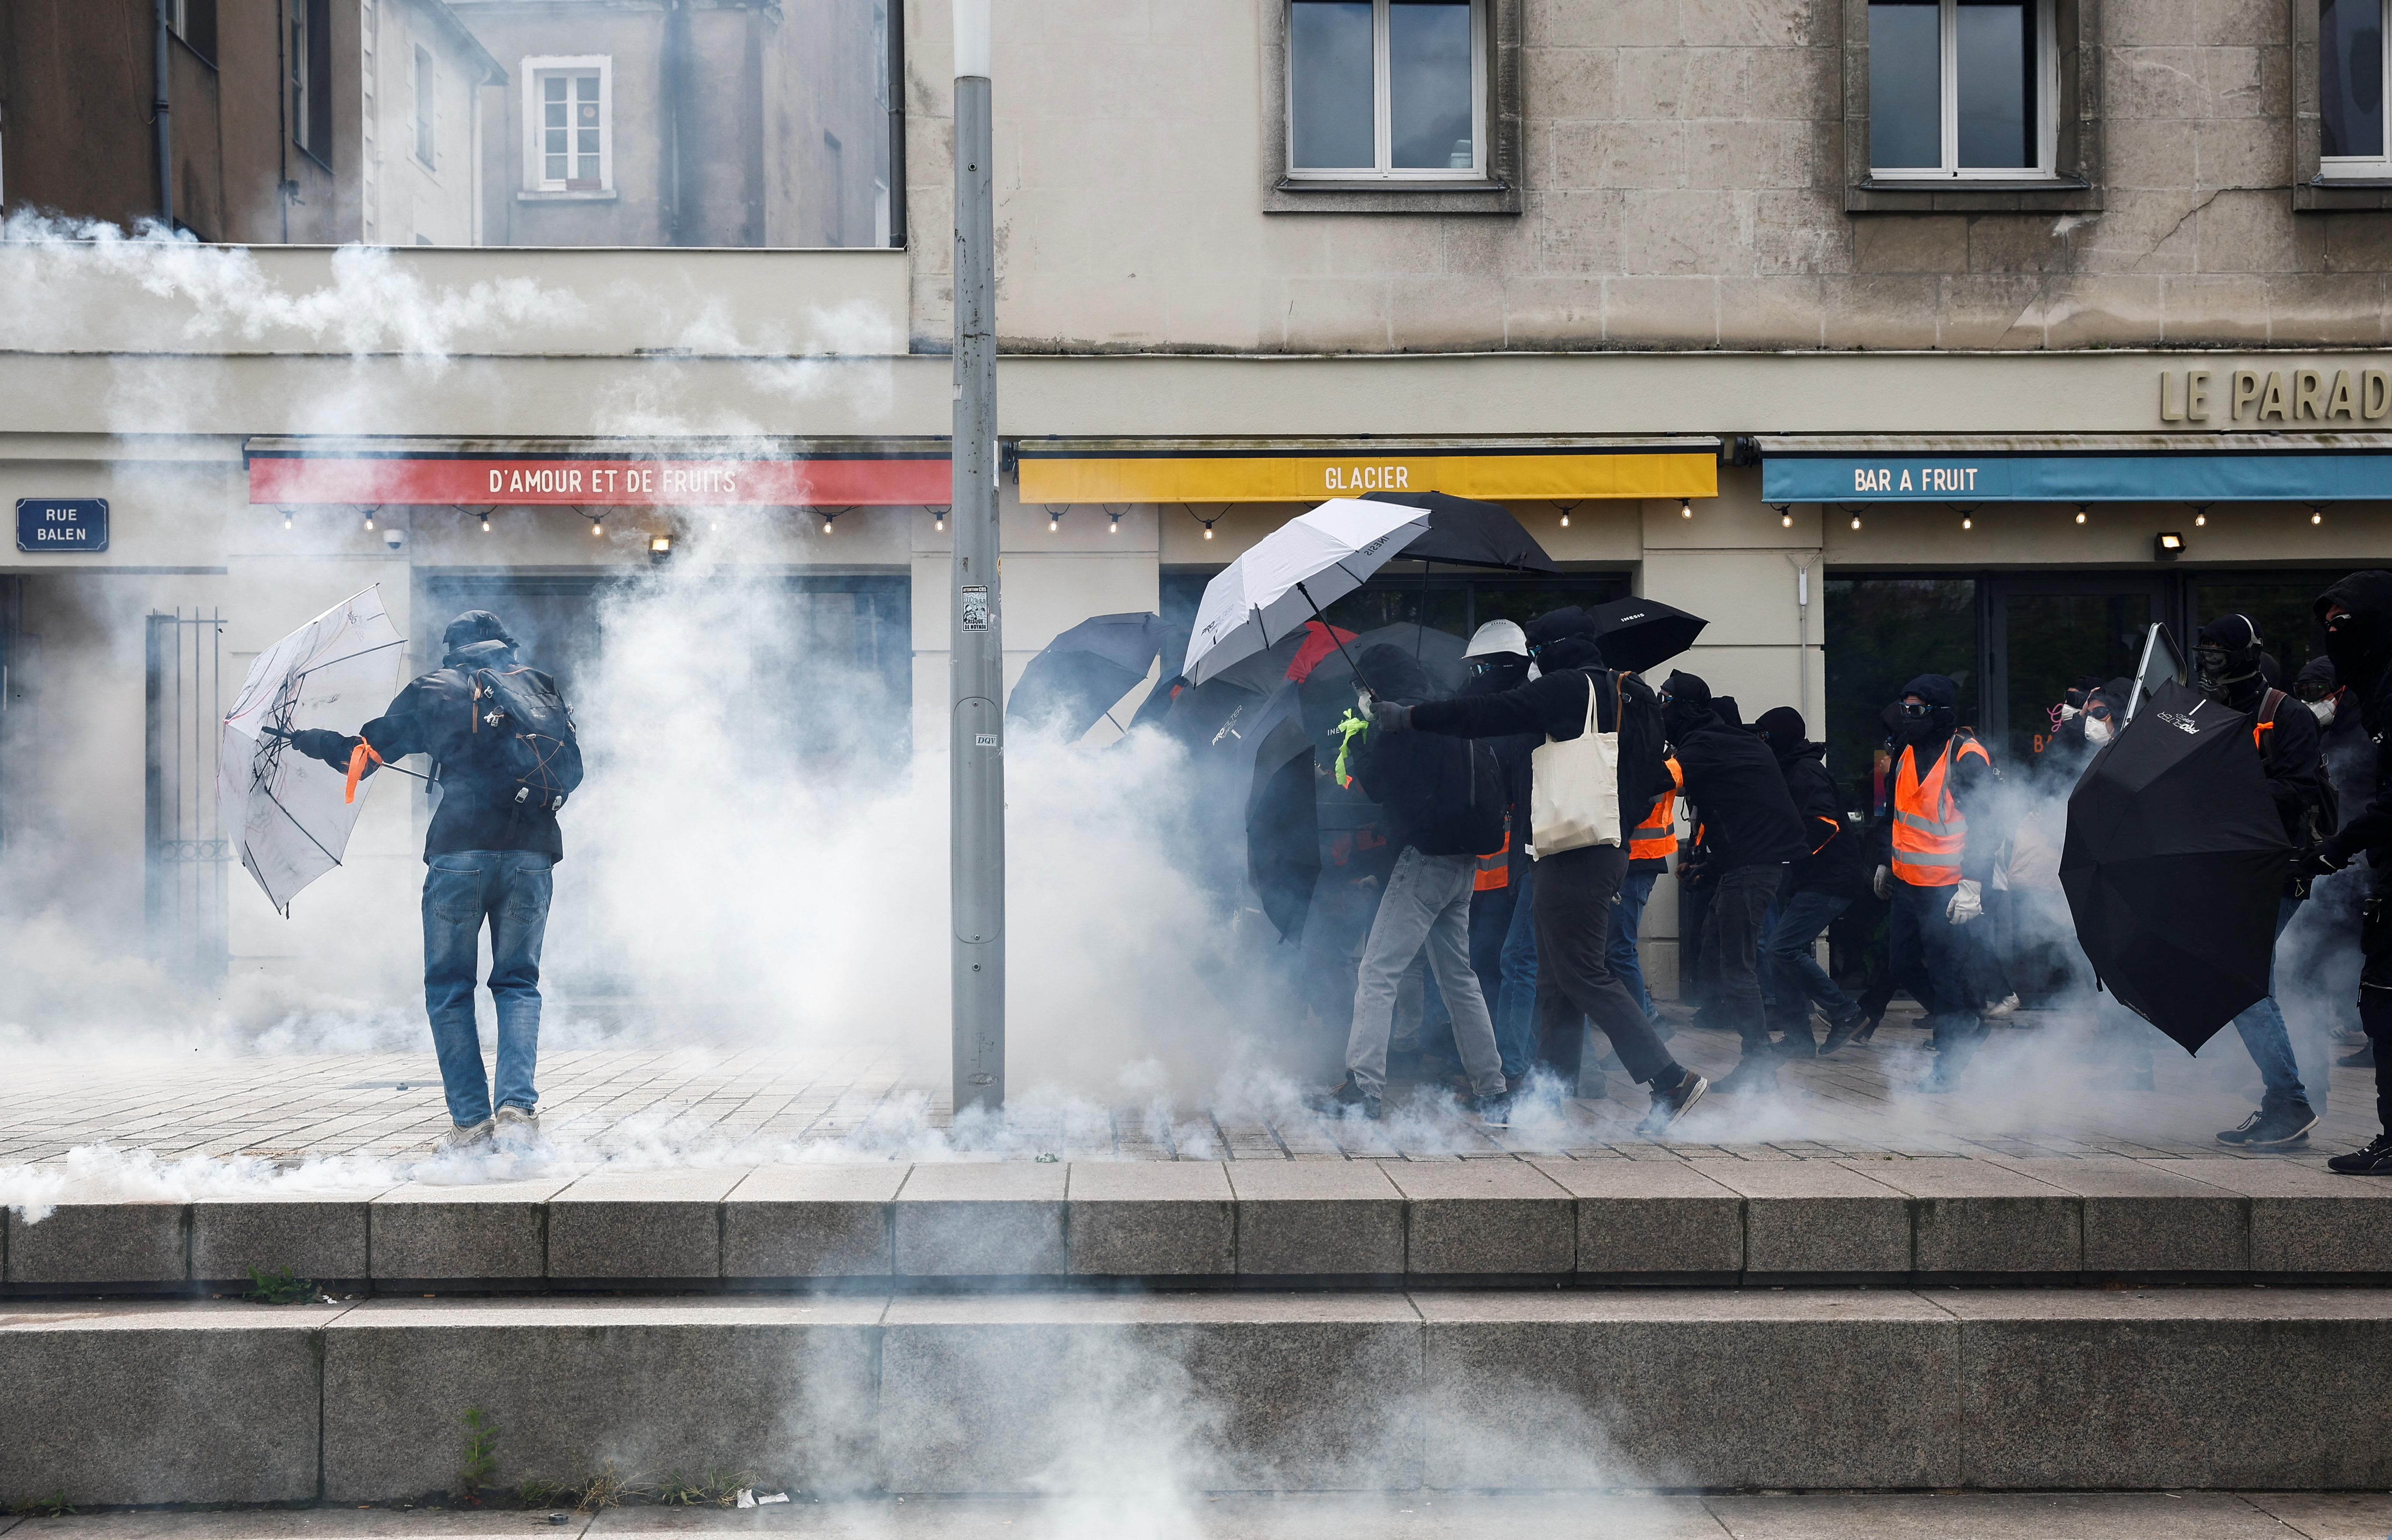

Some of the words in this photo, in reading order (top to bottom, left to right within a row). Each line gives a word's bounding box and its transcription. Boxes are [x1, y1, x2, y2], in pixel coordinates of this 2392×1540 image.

[2161, 370, 2210, 421] LE
[2232, 369, 2392, 420] PARAD
[490, 470, 582, 492] D'AMOUR
[592, 470, 618, 492] ET
[627, 470, 652, 492] DE
[663, 470, 736, 492] FRUITS
[1325, 466, 1408, 489] GLACIER
[1855, 469, 1891, 491] BAR
[1899, 469, 1913, 491] A
[1922, 468, 1978, 491] FRUIT
[46, 509, 77, 521] RUE
[37, 528, 86, 540] BALEN
[1620, 613, 1644, 622] INESIS
[1212, 705, 1242, 745] PROFILTER
[1327, 727, 1340, 736] INE
[2157, 712, 2200, 734] PROFILTER
